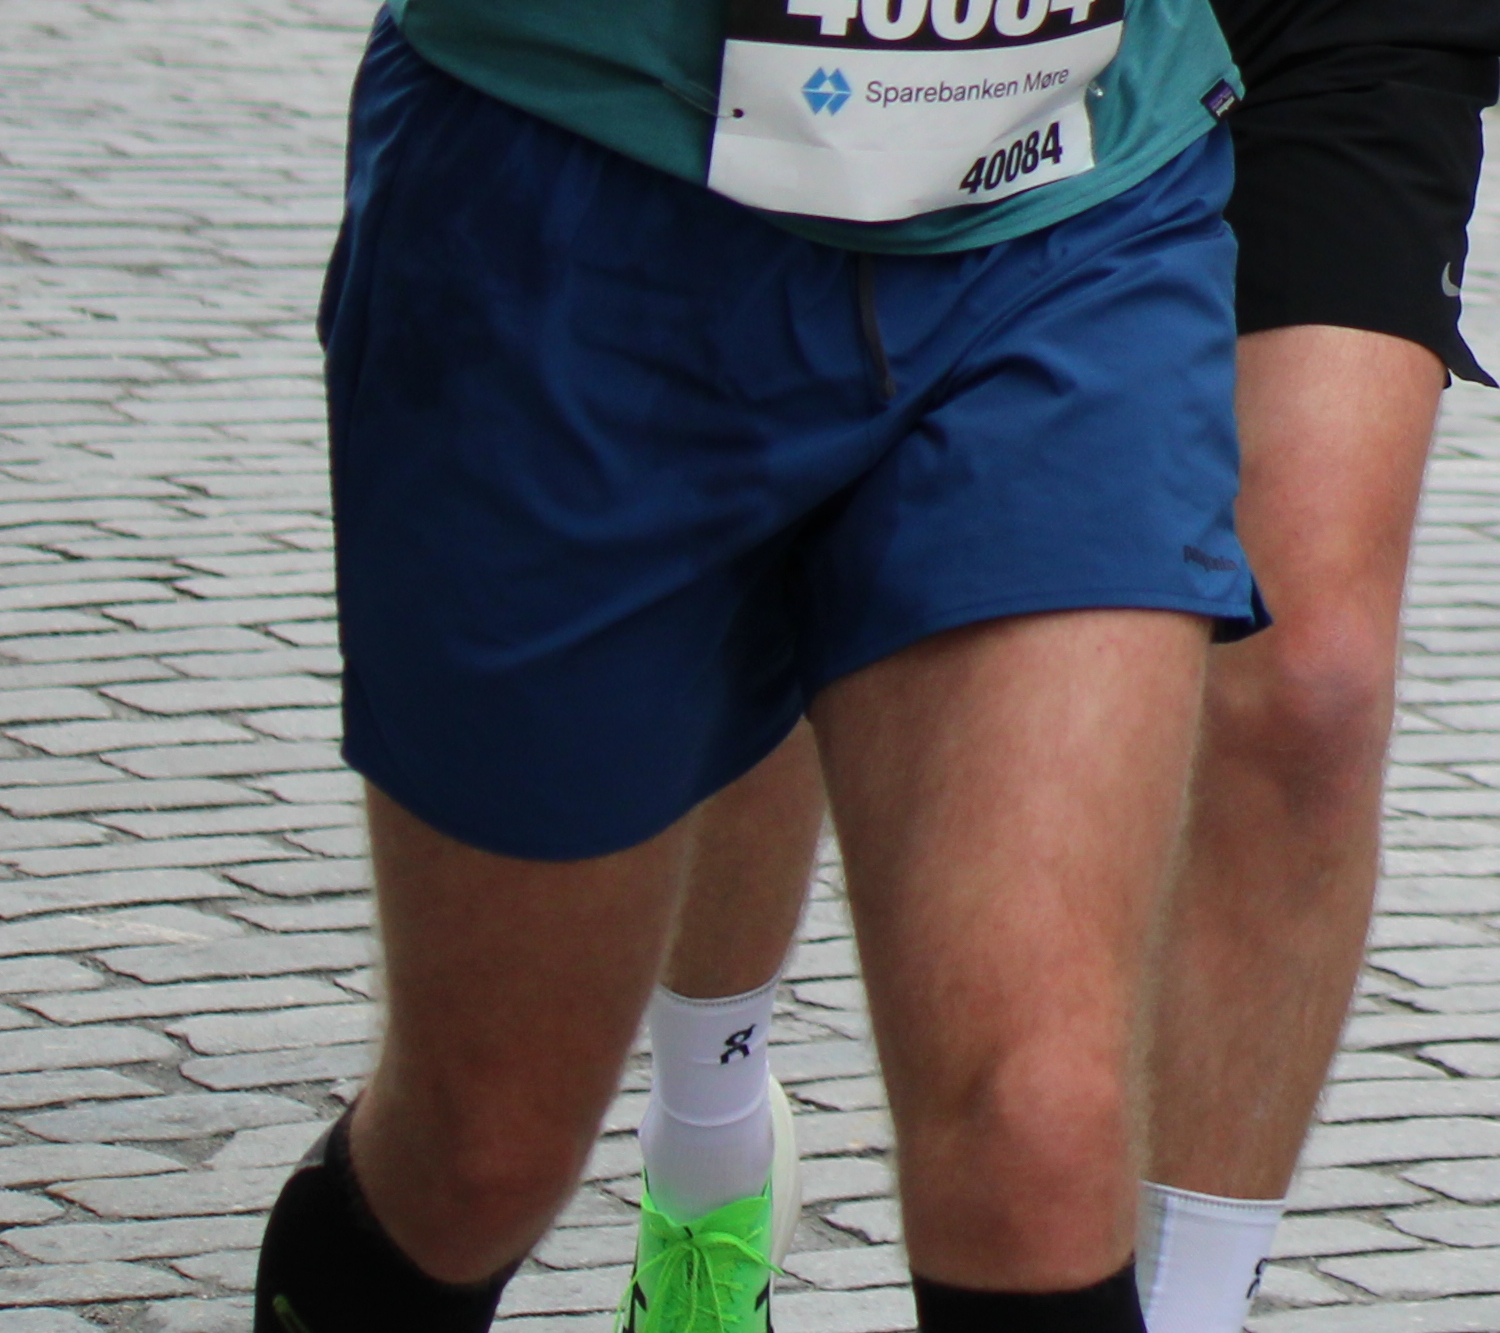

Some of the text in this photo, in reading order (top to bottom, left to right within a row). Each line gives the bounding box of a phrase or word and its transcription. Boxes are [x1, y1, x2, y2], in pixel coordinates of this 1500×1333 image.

[865, 66, 1069, 108] Sparebanken Møre
[958, 121, 1063, 196] 40084
